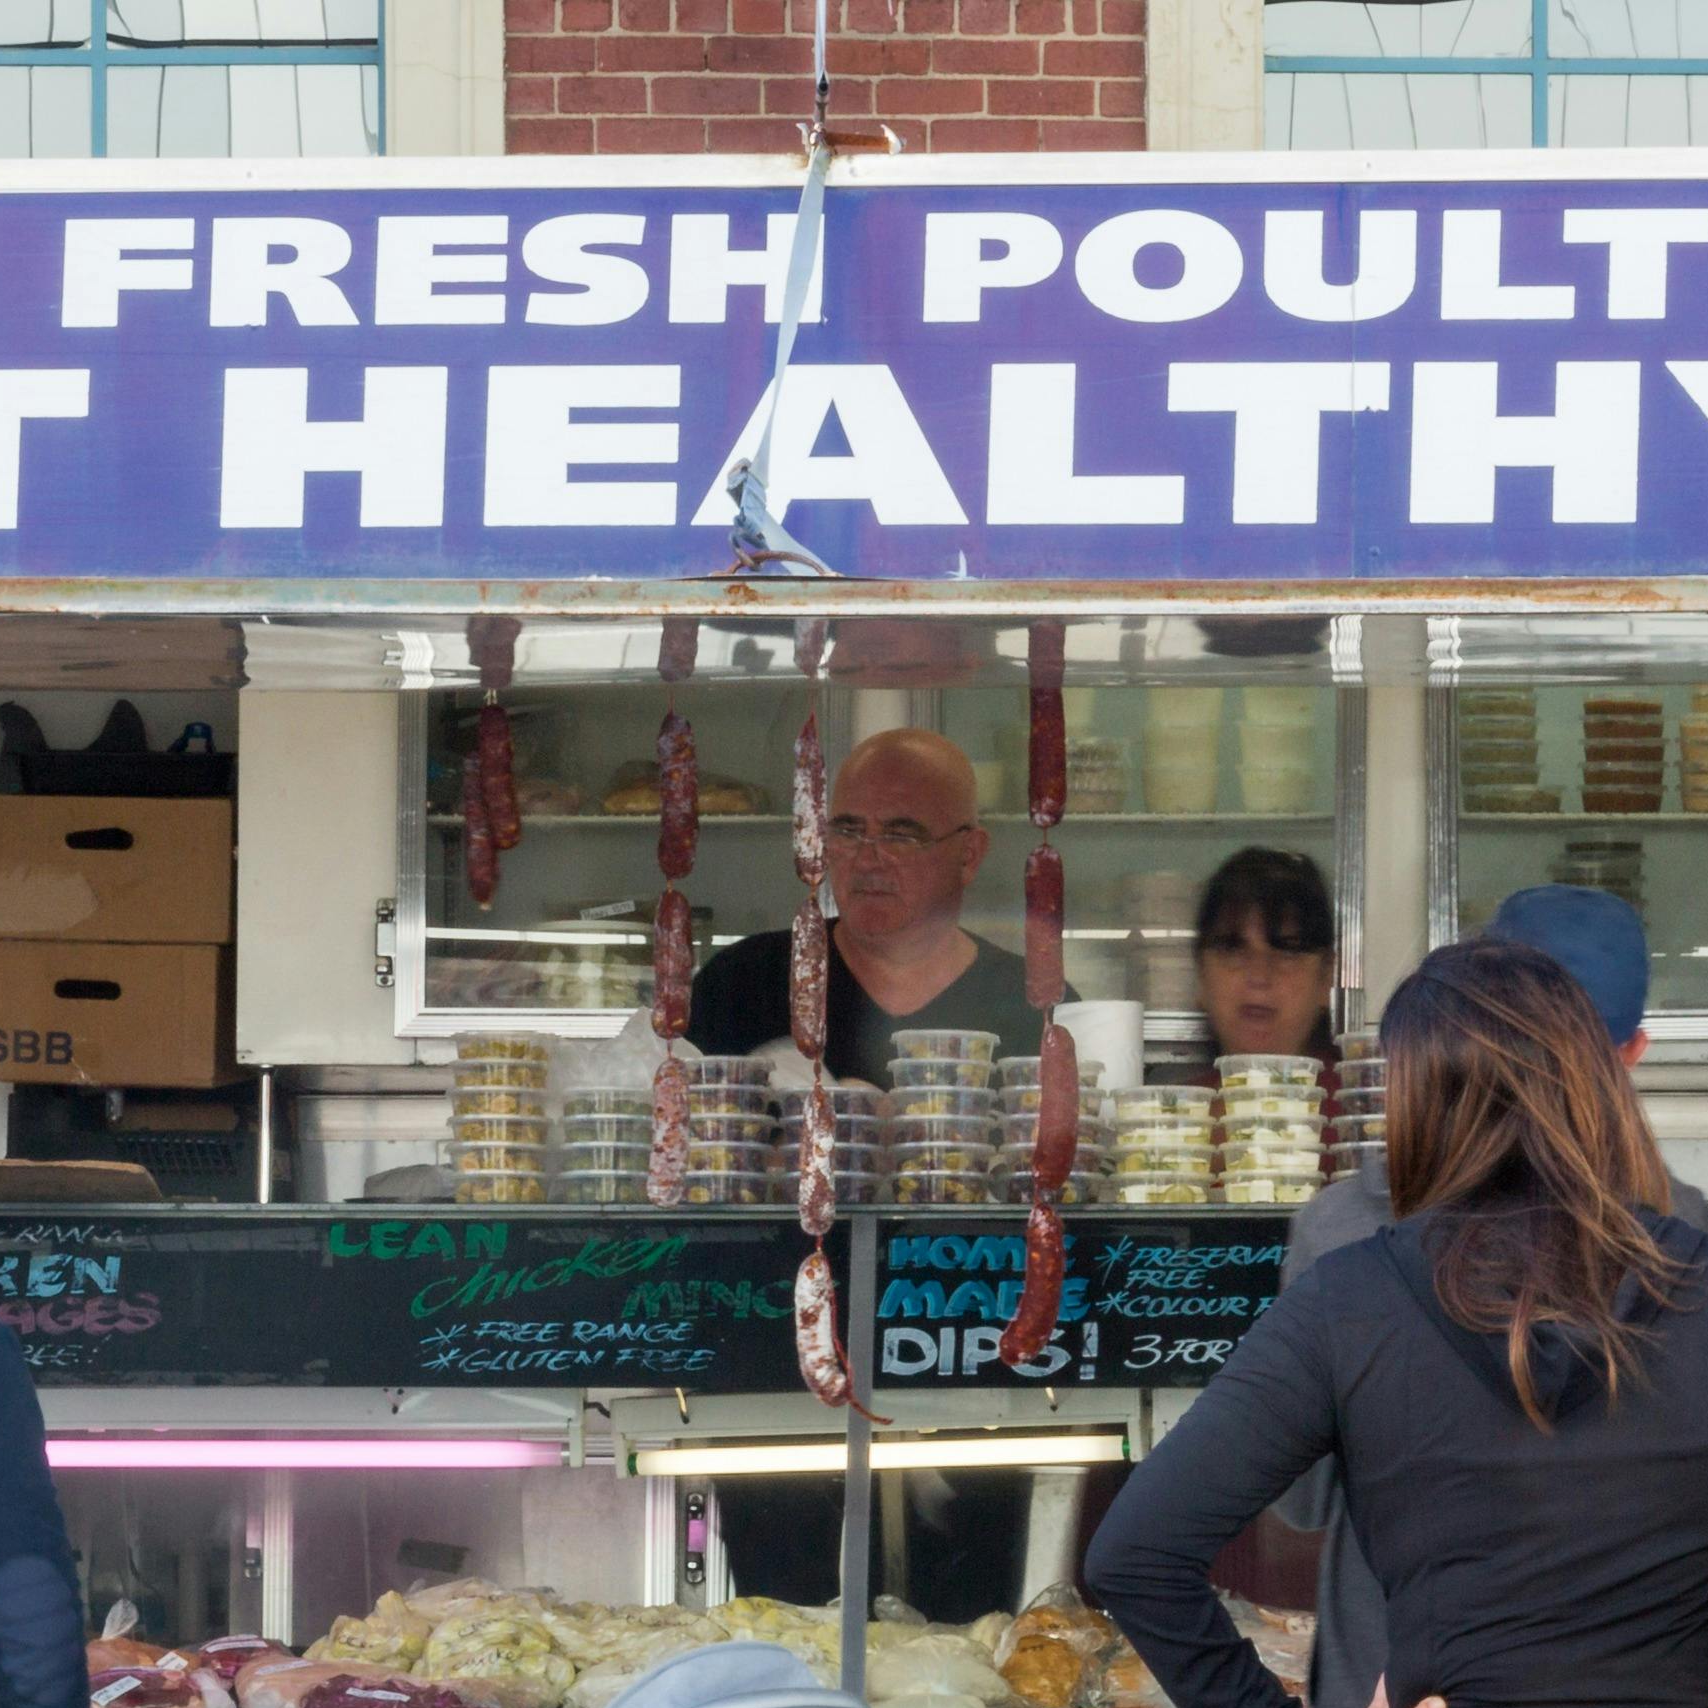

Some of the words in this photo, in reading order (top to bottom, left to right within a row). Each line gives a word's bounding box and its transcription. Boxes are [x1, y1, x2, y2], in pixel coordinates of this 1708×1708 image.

[61, 214, 826, 329] FRESH
[328, 1220, 509, 1261] LEAN
[621, 1278, 839, 1320] MINC
[1123, 1295, 1250, 1318] COLOUR
[472, 1320, 566, 1343] FREE
[572, 1319, 694, 1344] RANGE
[458, 1348, 606, 1374] GLUTEN
[614, 1348, 716, 1373] FREE
[1123, 1334, 1163, 1369] 3
[1163, 1337, 1234, 1365] FOR
